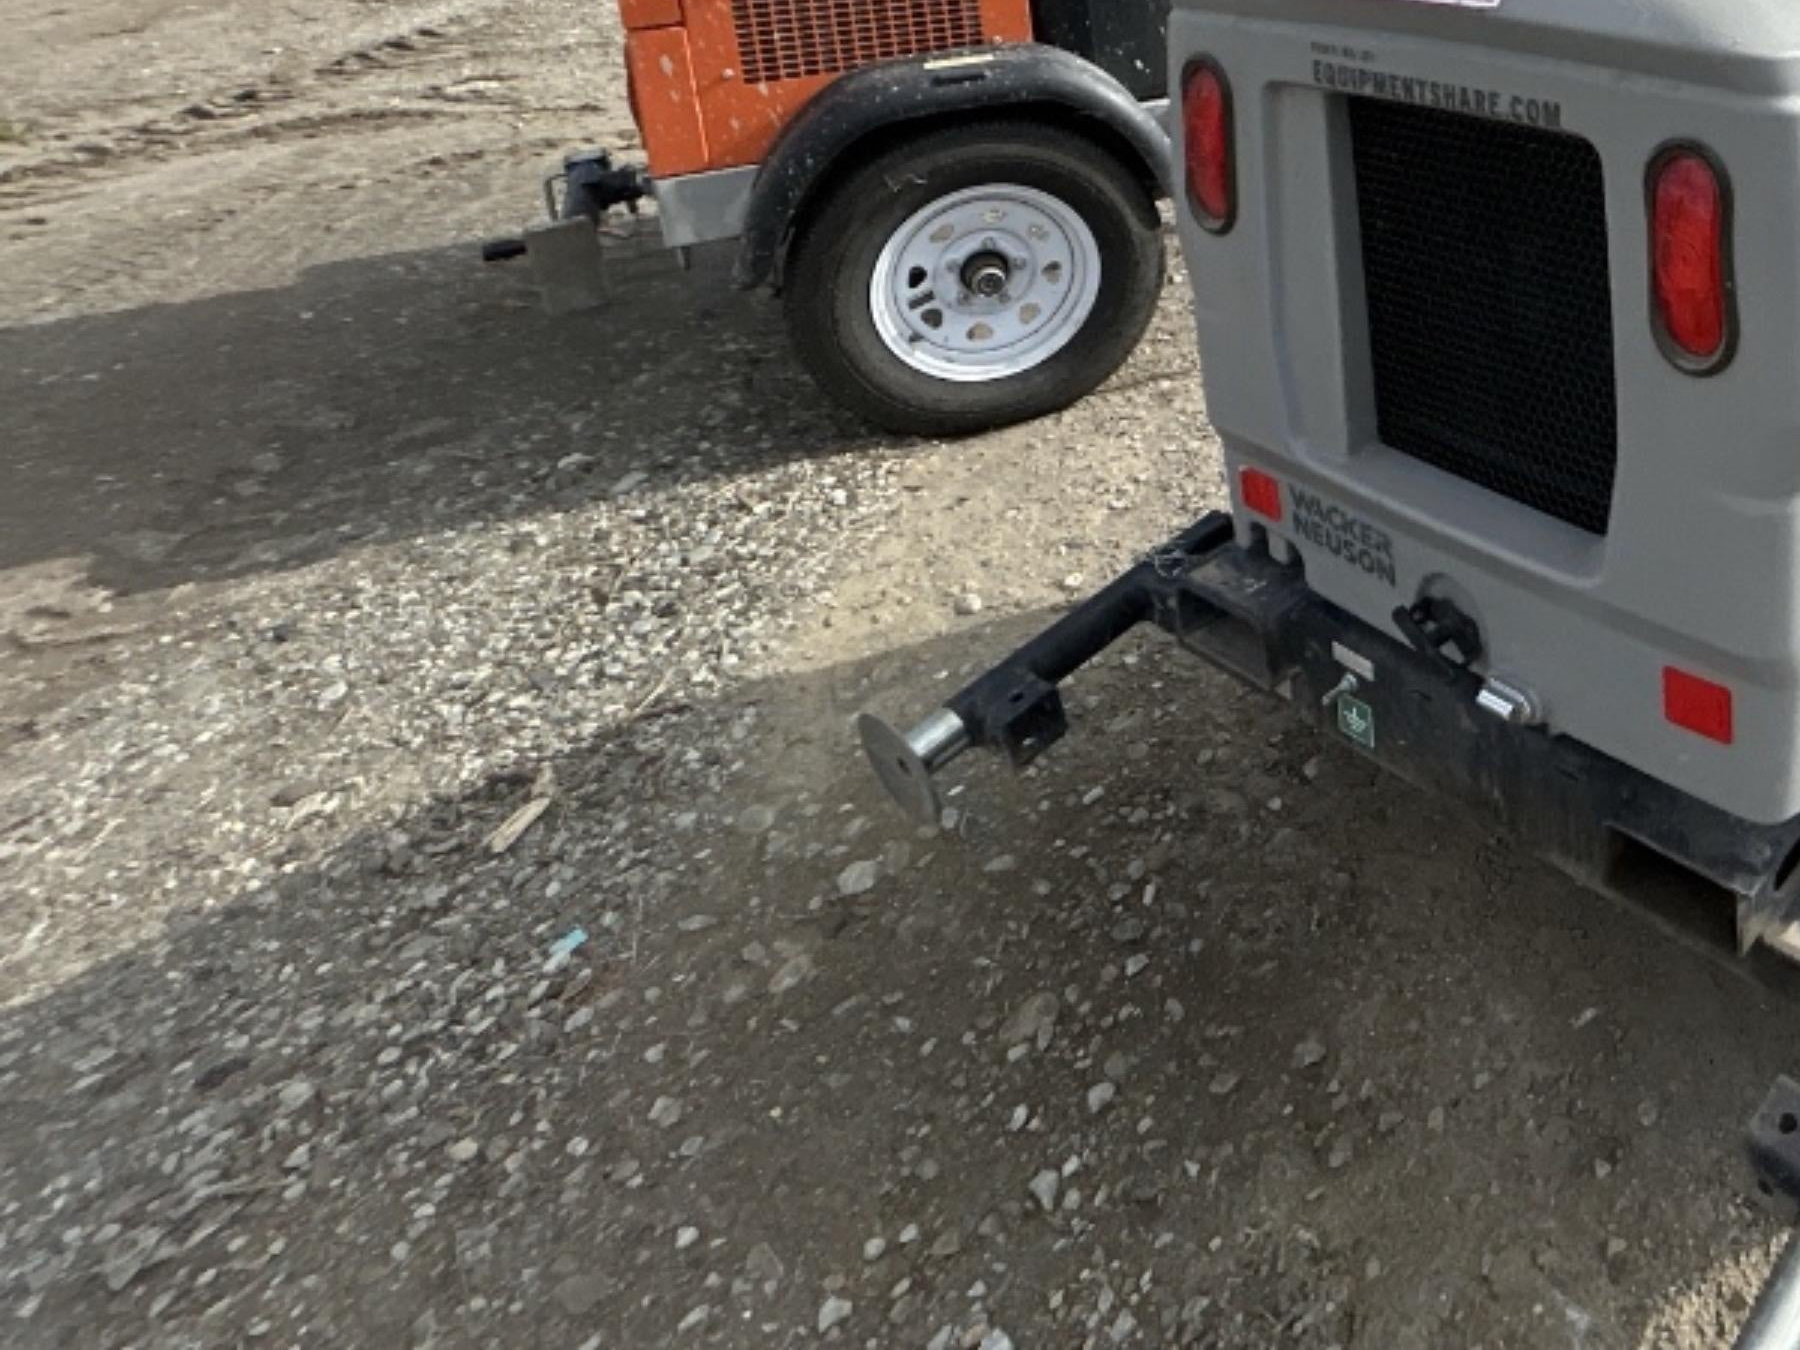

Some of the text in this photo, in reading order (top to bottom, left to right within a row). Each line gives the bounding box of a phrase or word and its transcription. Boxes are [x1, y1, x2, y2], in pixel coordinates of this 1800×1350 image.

[1312, 58, 1563, 128] EQUIPMENTSHARE.COM
[1288, 482, 1393, 553] WACKER
[1292, 512, 1396, 588] NEUSON
